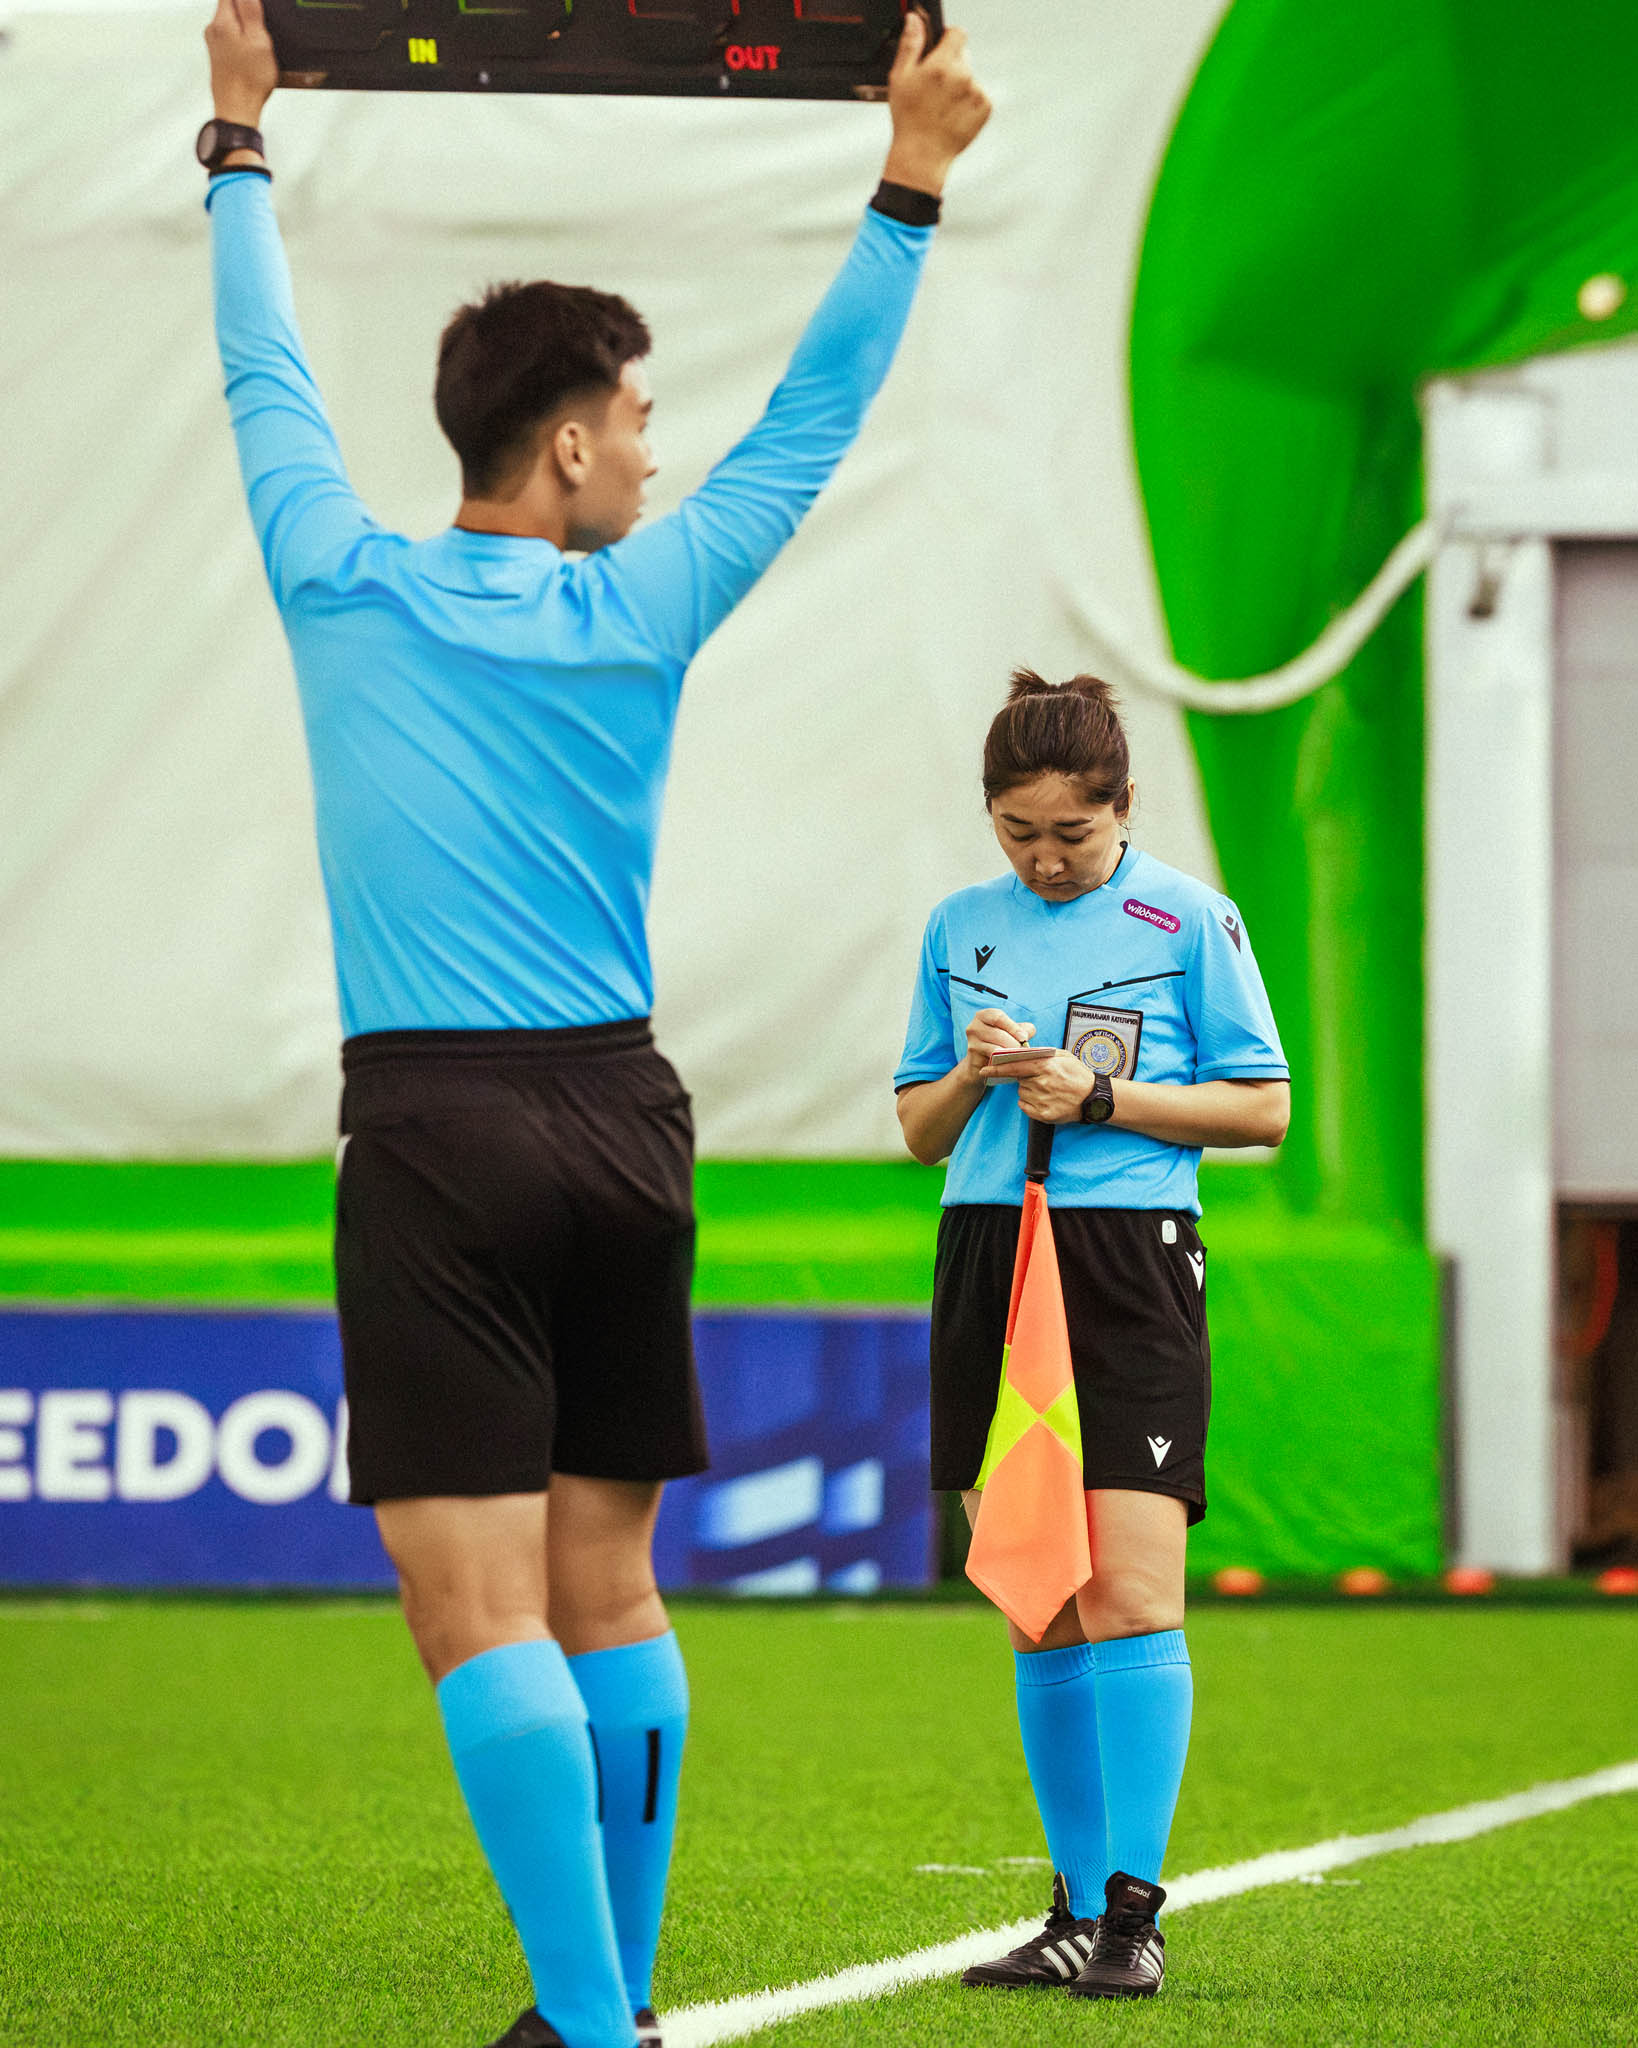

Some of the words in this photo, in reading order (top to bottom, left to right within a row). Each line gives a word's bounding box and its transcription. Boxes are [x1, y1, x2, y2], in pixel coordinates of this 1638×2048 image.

[408, 38, 438, 65] IN
[725, 44, 782, 71] OUT
[1127, 903, 1177, 931] wildberries
[1072, 1010, 1110, 1022] НАЦИОНАЛЬНАЯ
[1110, 1015, 1138, 1026] КАТЕГОРИЯ
[0, 1388, 349, 1505] EDO
[1127, 1885, 1152, 1899] adidas
